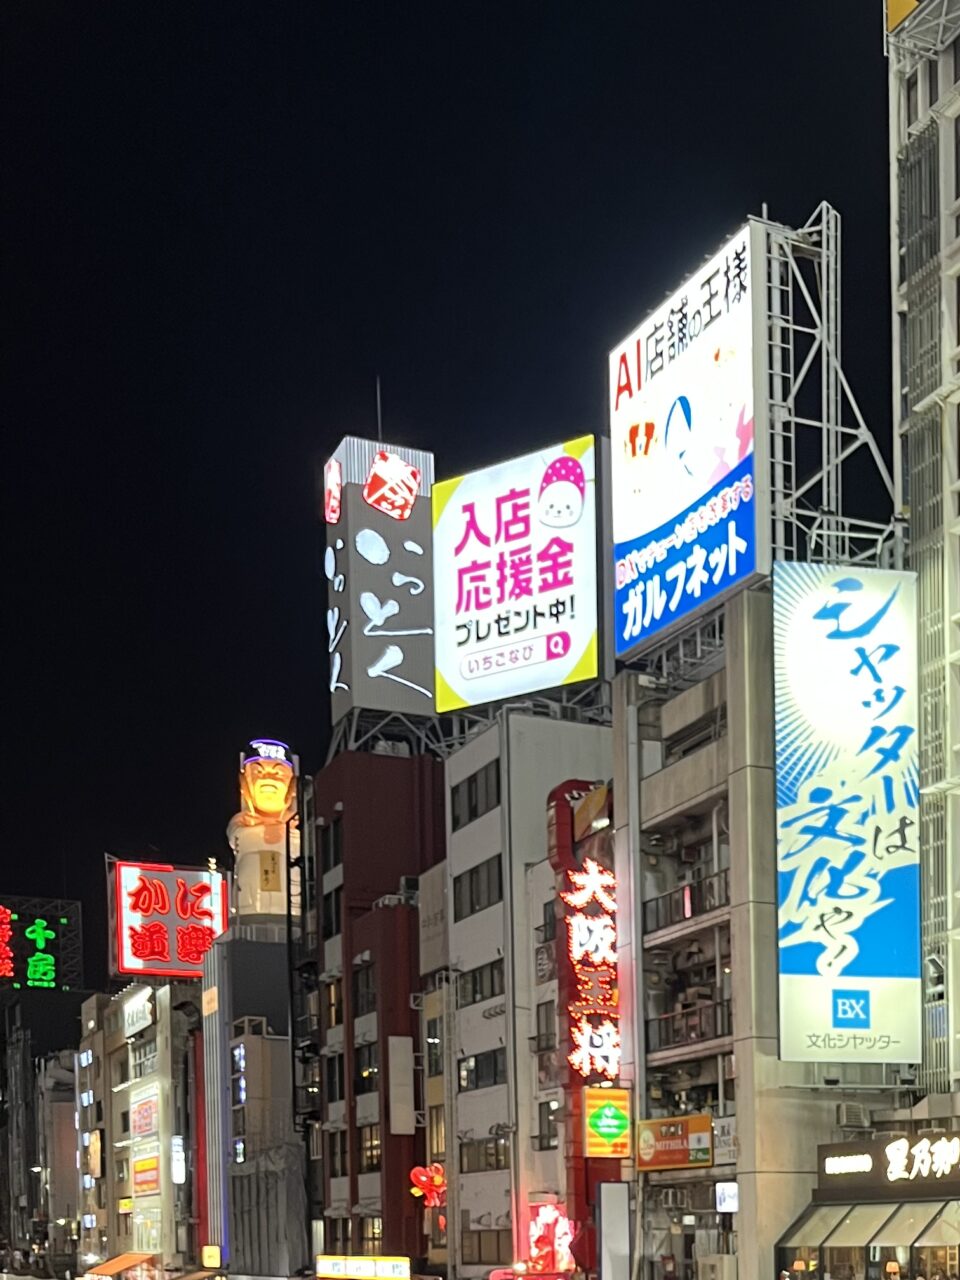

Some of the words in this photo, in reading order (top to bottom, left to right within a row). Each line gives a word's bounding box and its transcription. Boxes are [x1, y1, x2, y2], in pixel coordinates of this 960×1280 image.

[454, 487, 531, 556] 入店
[455, 536, 574, 615] 応援金
[622, 520, 748, 641] ガルフネット
[455, 595, 576, 647] プレゼント中!
[468, 644, 533, 673] いちこなび
[127, 876, 216, 919] かに
[128, 921, 217, 964] 道楽
[560, 858, 623, 1079] 大阪王将
[836, 998, 867, 1019] BX
